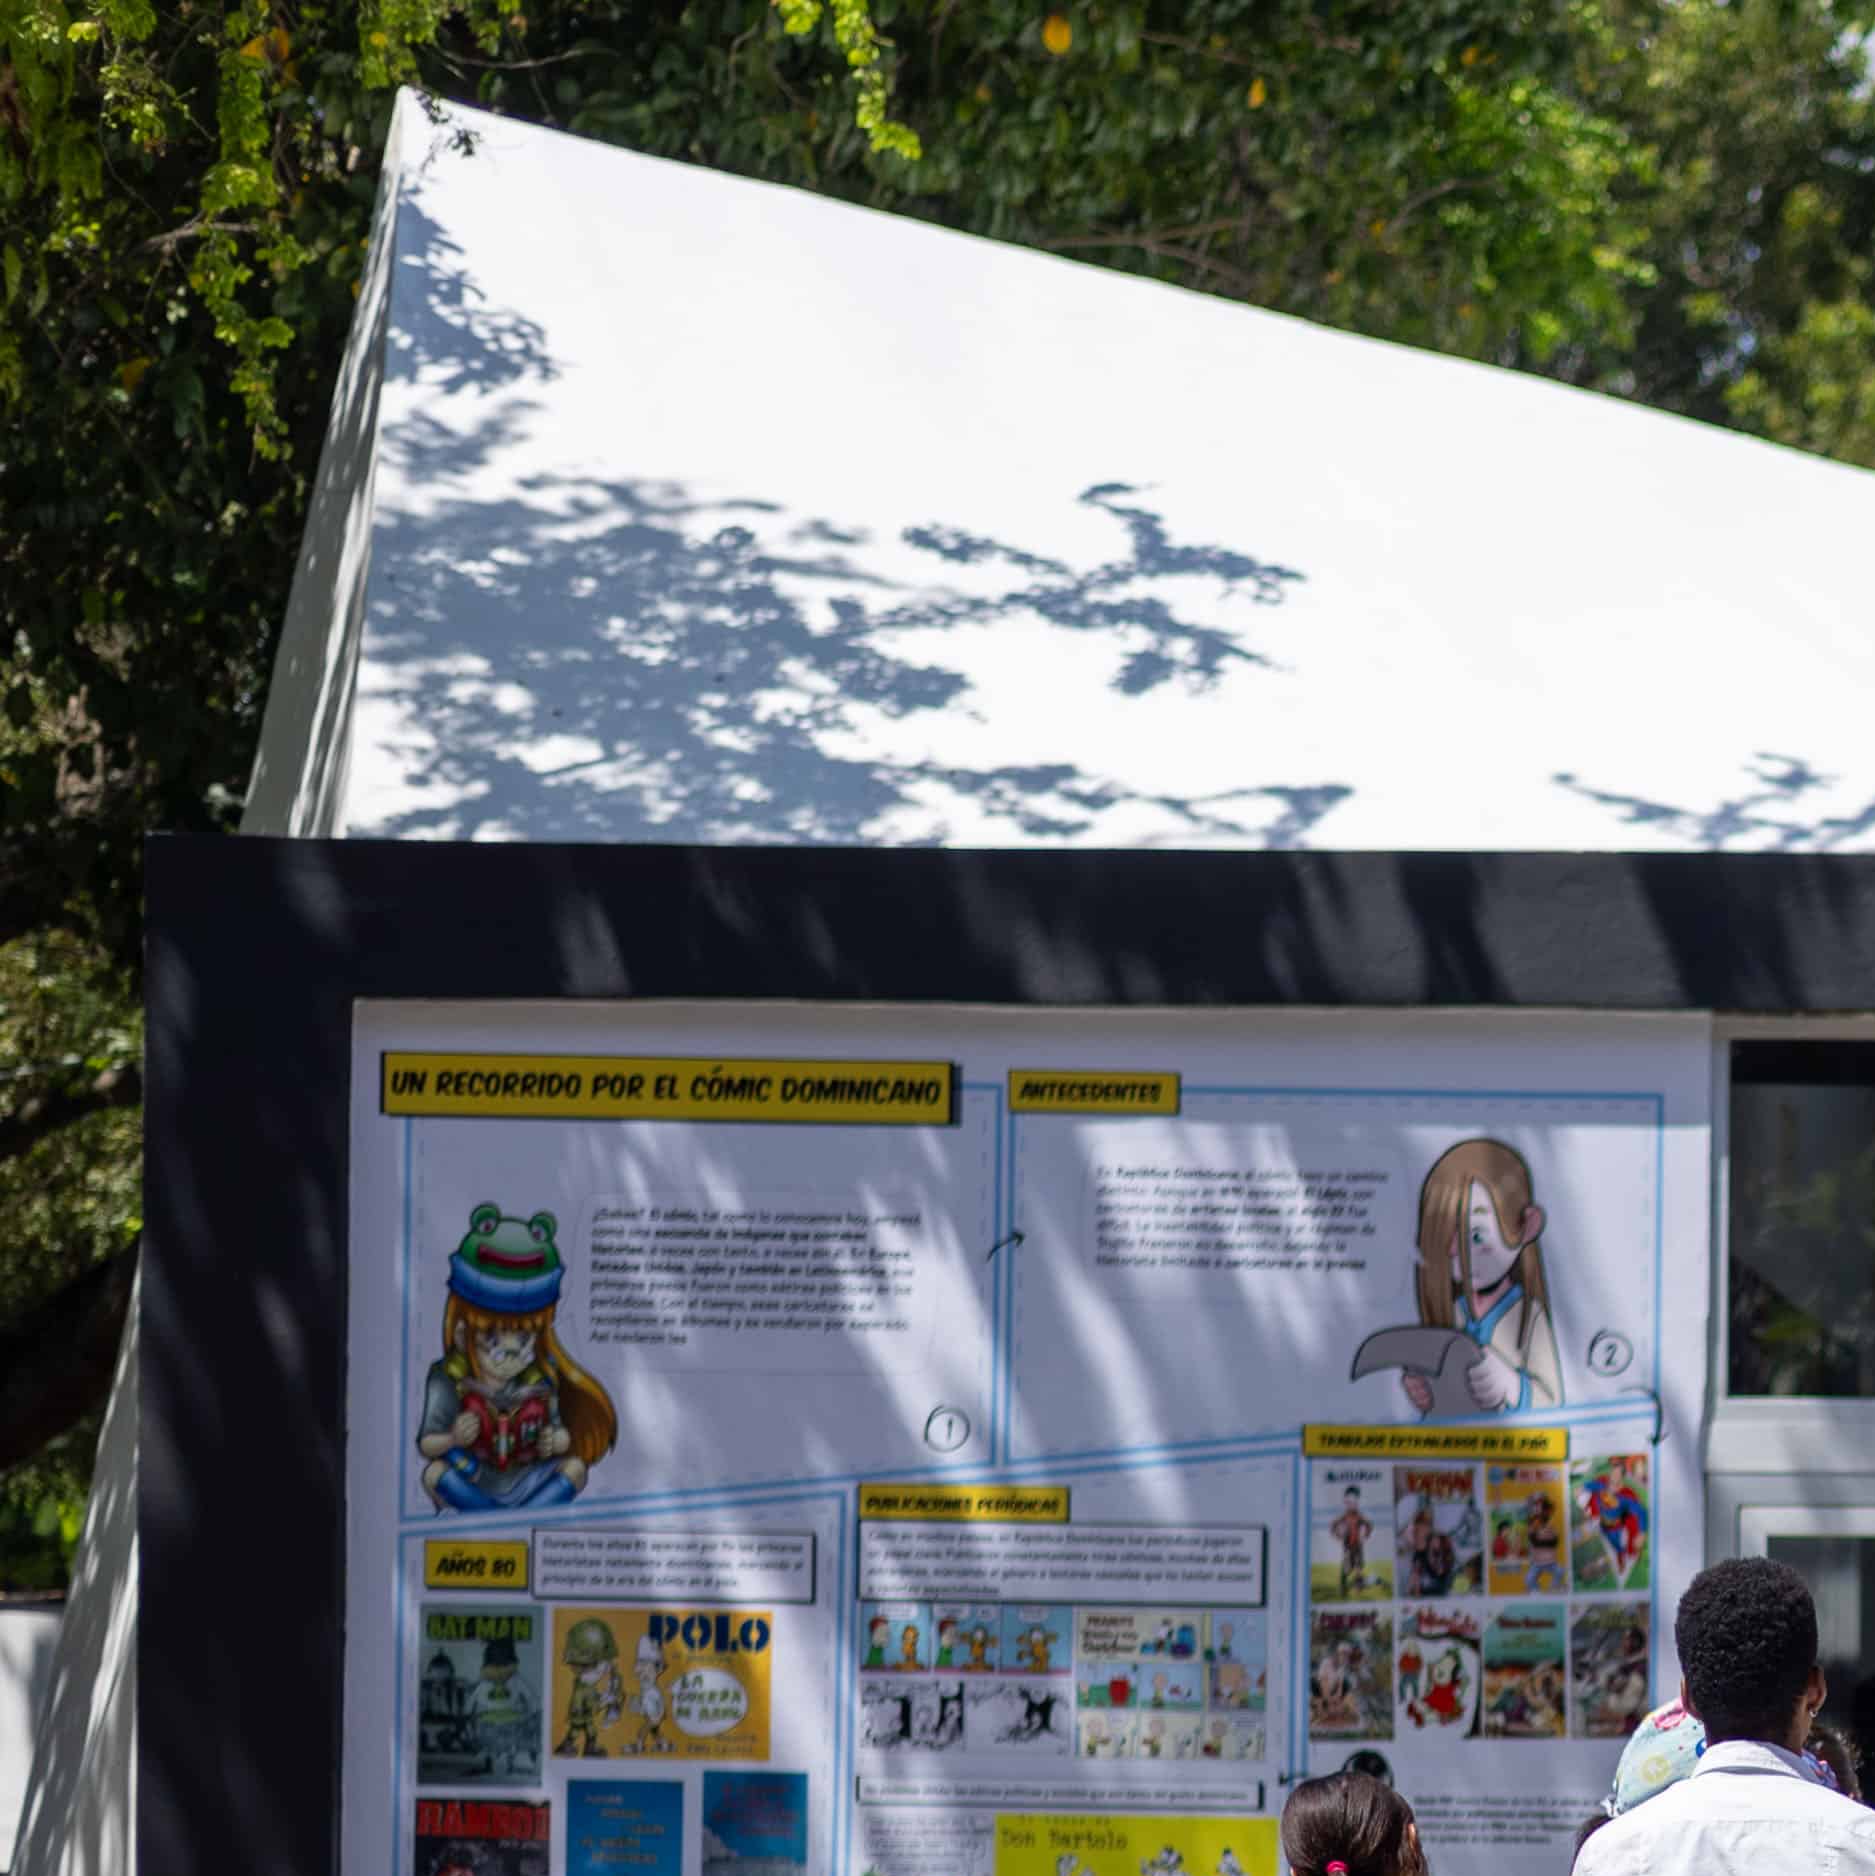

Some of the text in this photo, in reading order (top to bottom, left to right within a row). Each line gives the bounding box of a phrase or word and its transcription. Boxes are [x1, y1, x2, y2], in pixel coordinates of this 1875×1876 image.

[391, 1066, 943, 1106] UN RECORRIDO POR EL CÓMIC DOMINICANO
[1018, 1080, 1164, 1103] ANTECEDENTES
[1603, 1343, 1621, 1368] 2
[866, 1496, 972, 1513] PUBLICACIONES
[435, 1550, 517, 1579] AÑOS 80
[647, 1614, 771, 1654] POLO
